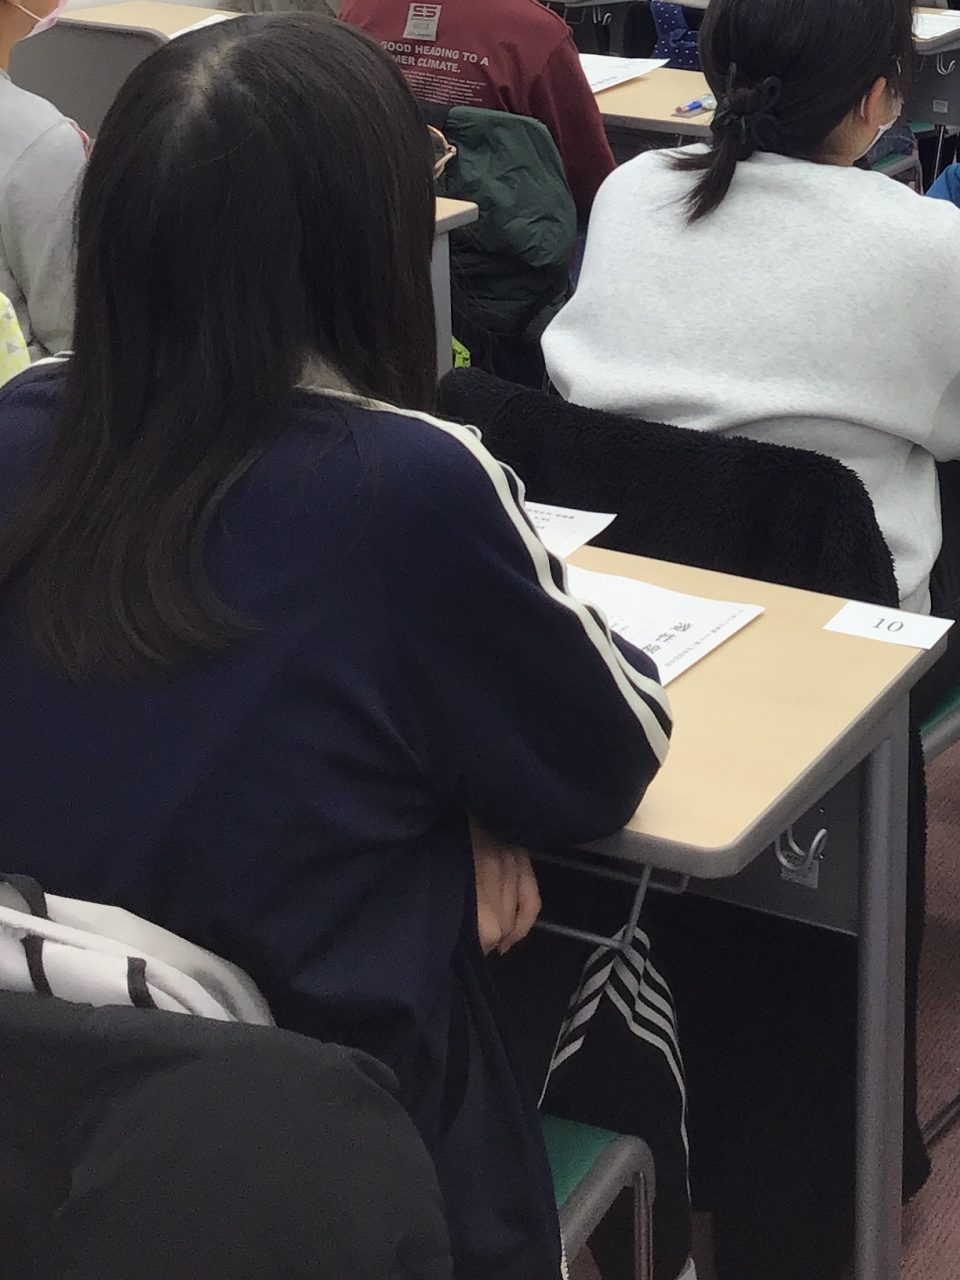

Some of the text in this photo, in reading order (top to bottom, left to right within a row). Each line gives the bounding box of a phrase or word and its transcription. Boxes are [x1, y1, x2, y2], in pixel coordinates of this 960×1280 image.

[415, 45, 460, 60] HEADING
[462, 51, 478, 63] TO
[480, 57, 489, 66] A
[417, 58, 461, 73] CLIMATE.
[873, 617, 904, 634] 10
